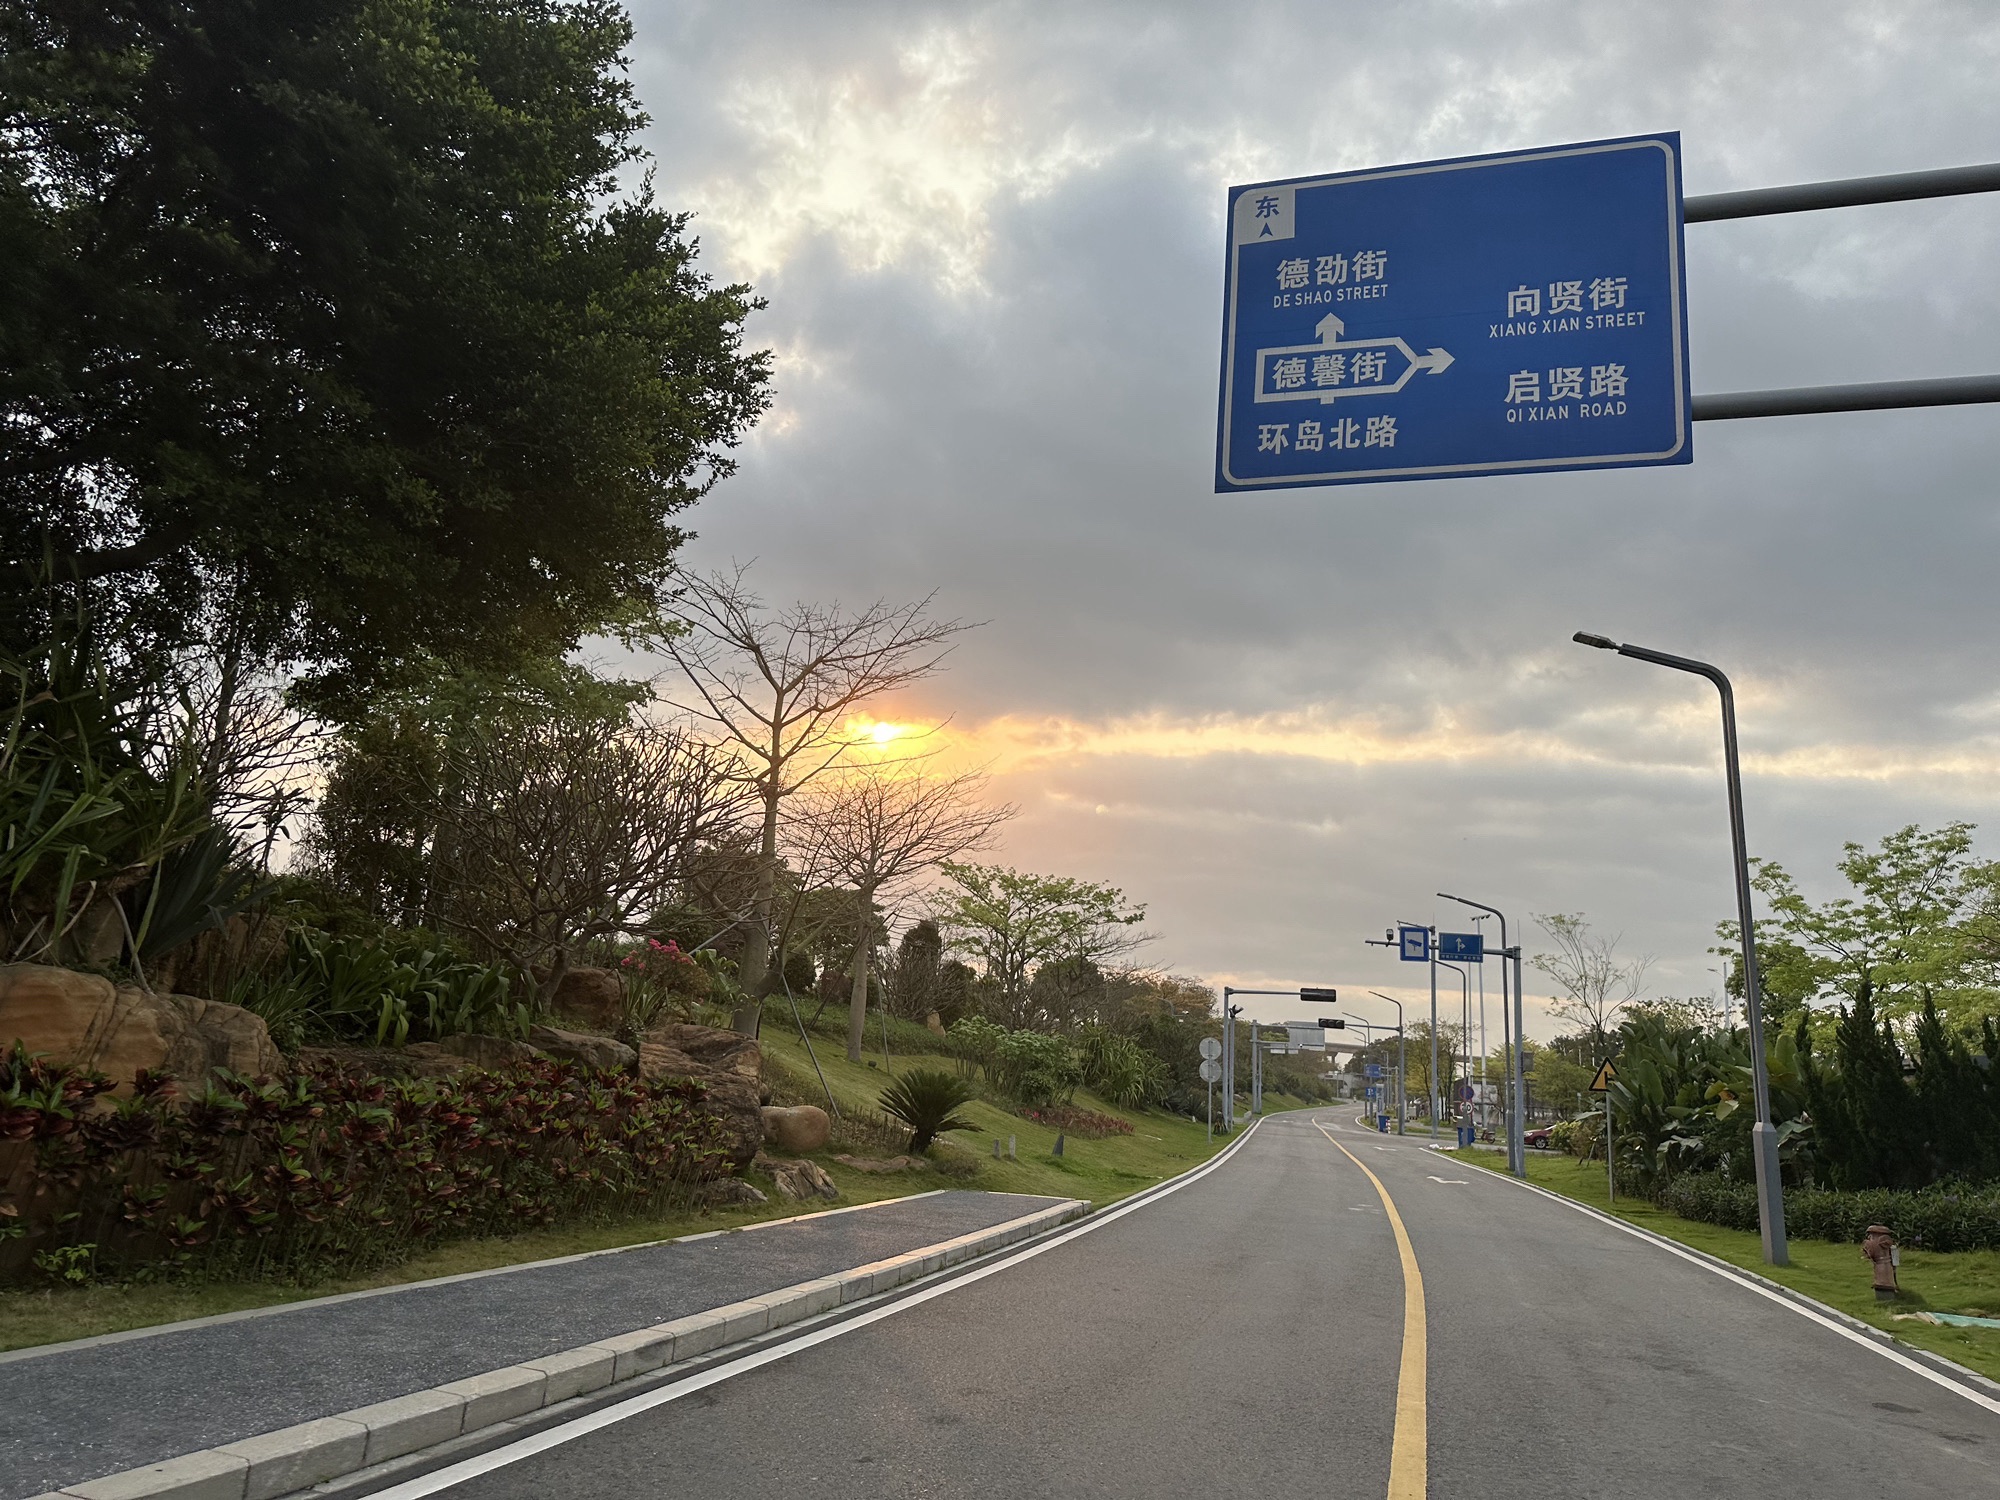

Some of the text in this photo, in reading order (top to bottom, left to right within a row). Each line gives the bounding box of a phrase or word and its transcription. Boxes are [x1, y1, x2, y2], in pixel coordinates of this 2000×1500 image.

[1255, 196, 1279, 218] 东
[1276, 250, 1387, 290] 德劭街
[1273, 284, 1388, 308] DE SHAO STREET
[1507, 277, 1628, 318] 向贤街
[1489, 311, 1646, 338] XIANG XIAN STREET
[1272, 352, 1386, 390] 德馨街
[1504, 363, 1629, 403] 启贤路
[1506, 401, 1627, 423] QI XIAN ROAD
[1258, 415, 1398, 454] 环岛北路
